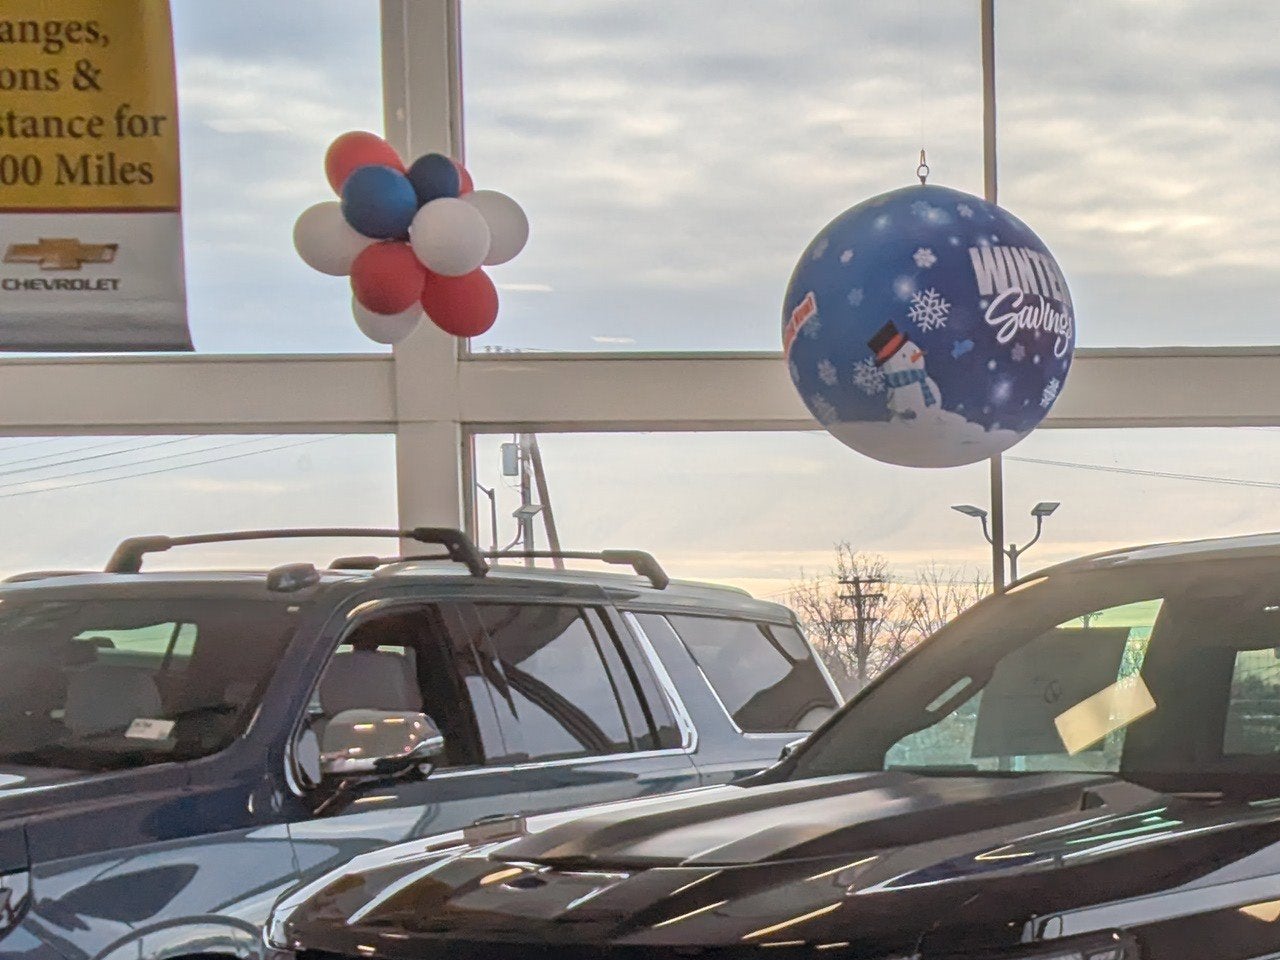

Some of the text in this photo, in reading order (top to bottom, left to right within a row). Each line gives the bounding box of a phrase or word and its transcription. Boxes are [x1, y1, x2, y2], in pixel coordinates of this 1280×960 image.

[73, 59, 102, 91] &
[115, 103, 167, 138] for
[55, 152, 154, 185] Miles
[2, 278, 120, 291] CHEVROLET
